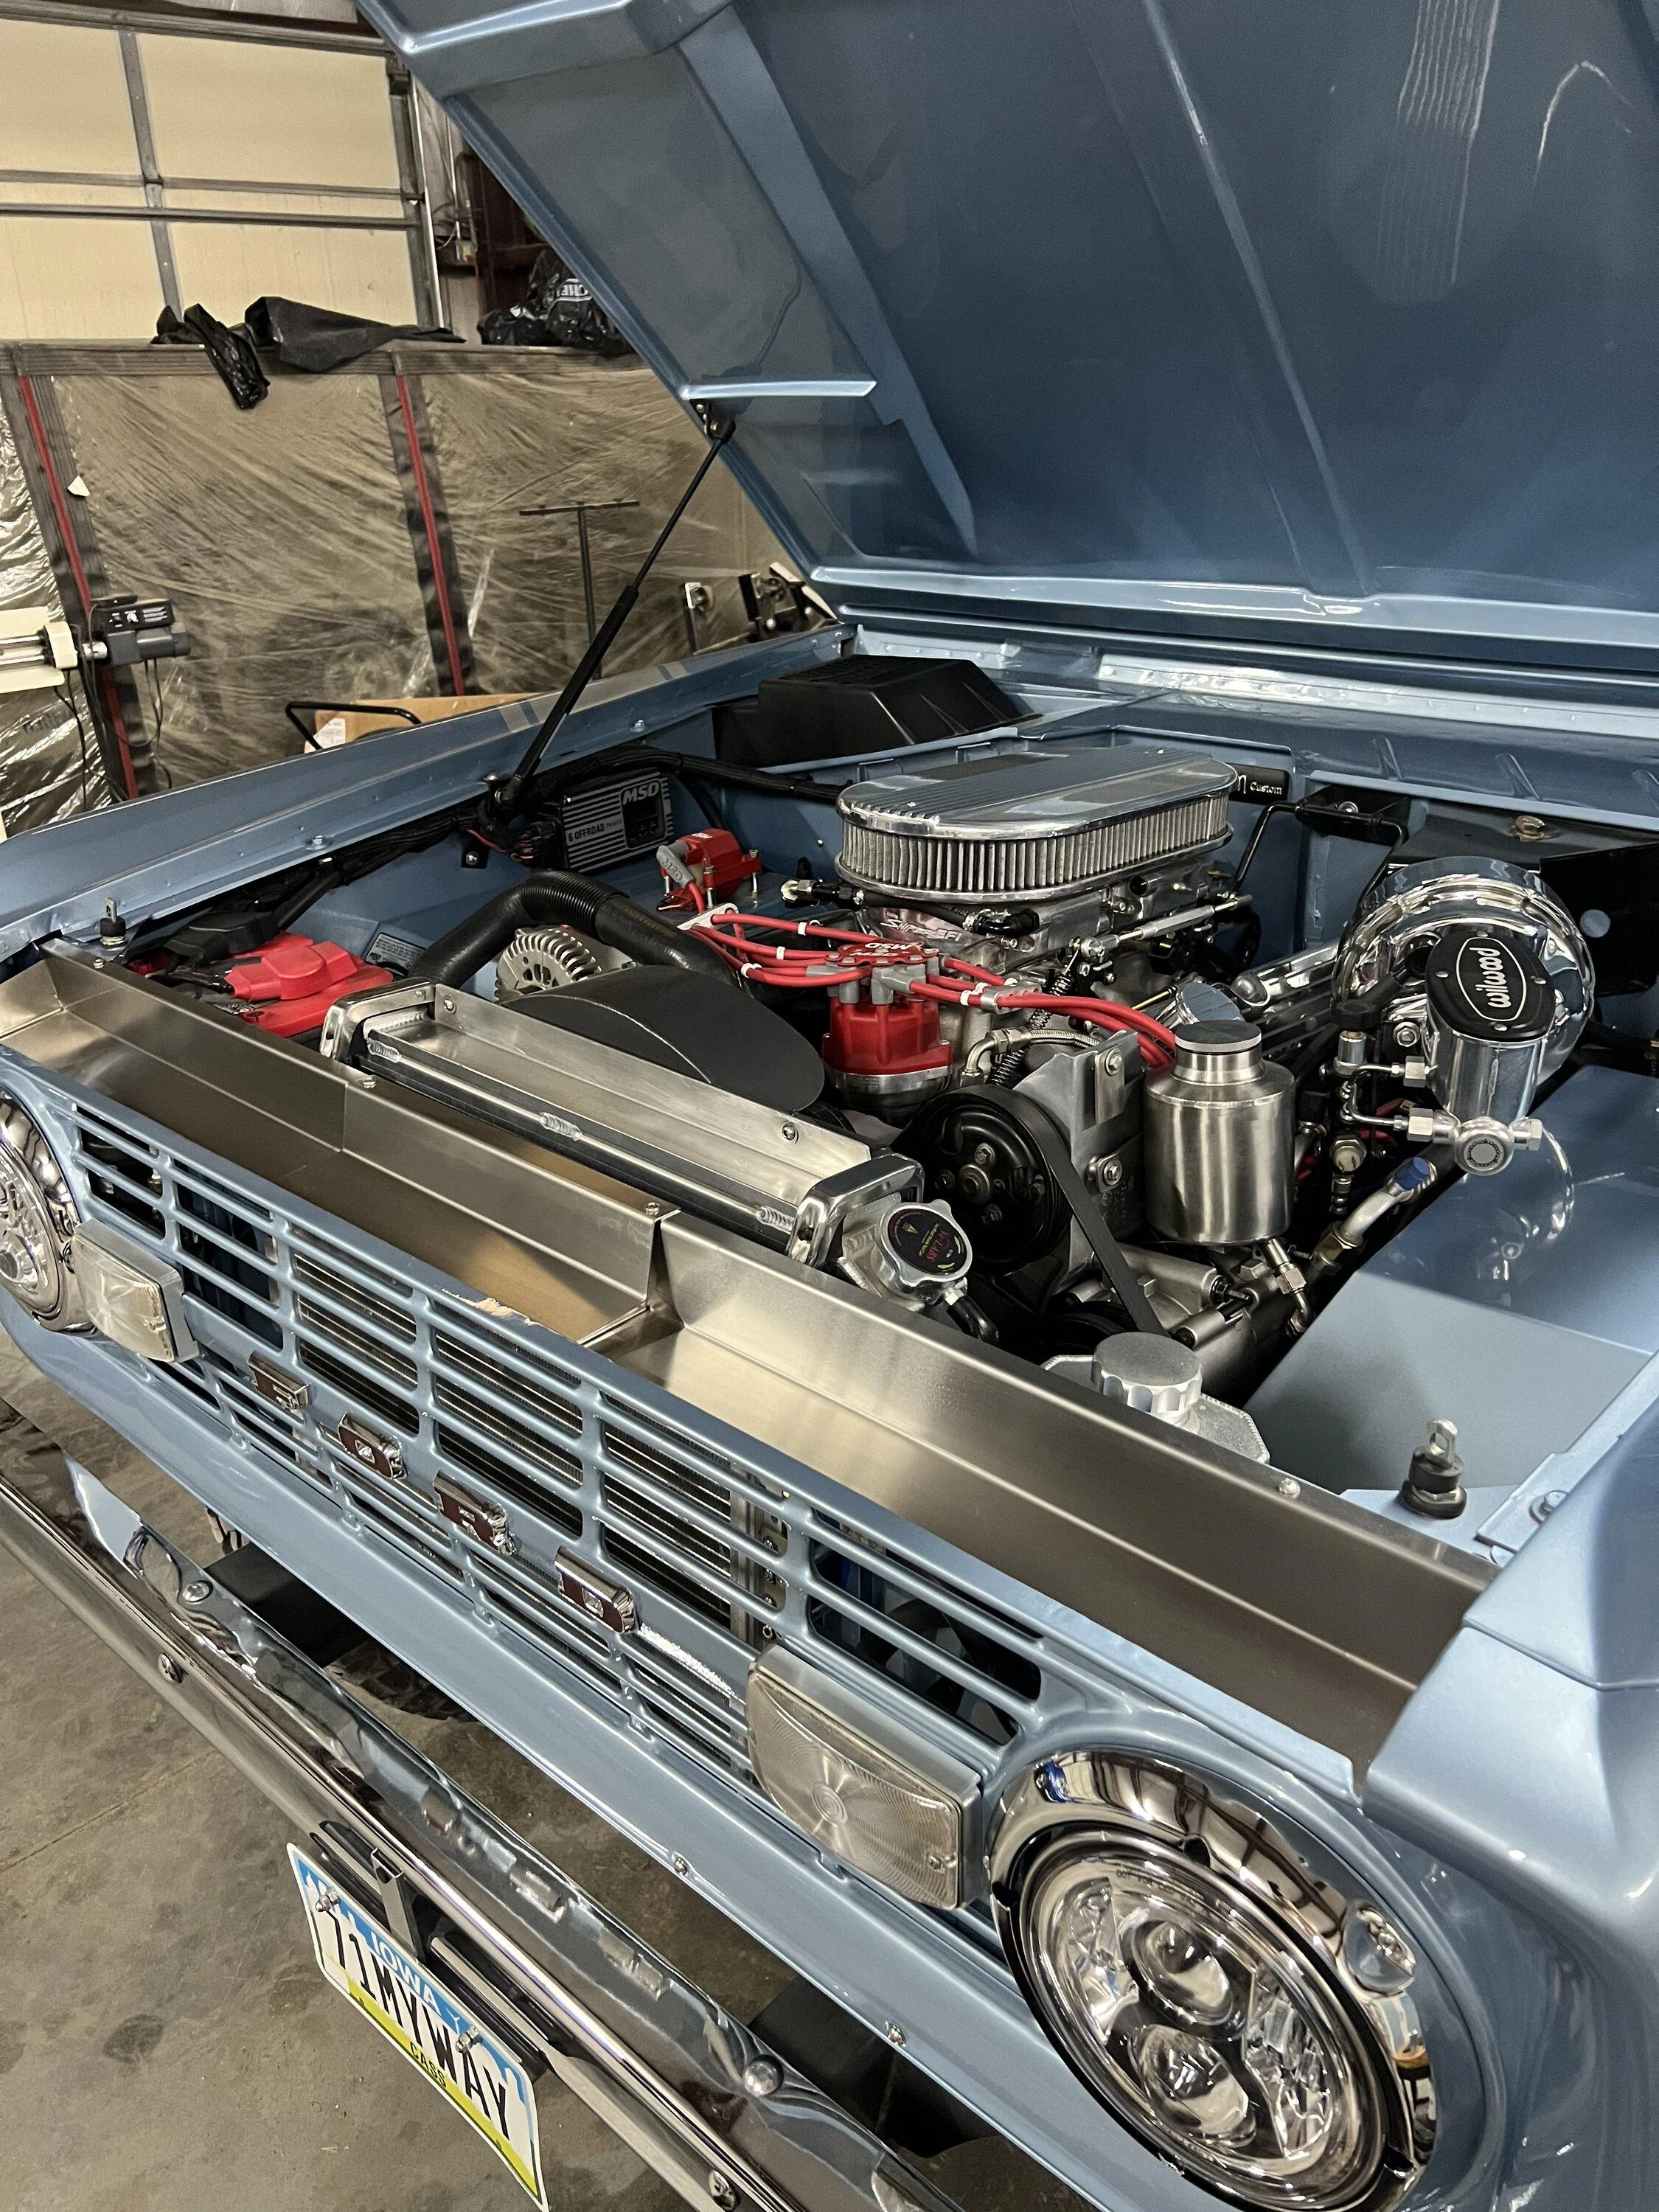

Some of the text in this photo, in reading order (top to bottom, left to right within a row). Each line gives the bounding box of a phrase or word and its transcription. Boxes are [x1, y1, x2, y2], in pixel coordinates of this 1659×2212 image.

[622, 781, 660, 805] MSD
[1250, 782, 1282, 795] Custom
[568, 832, 574, 842] 6
[574, 823, 605, 841] OFFROAD
[1469, 947, 1512, 1008] wilwood
[371, 1930, 442, 2014] IOWA
[327, 1910, 511, 2141] 71MYWAY
[409, 2041, 448, 2089] CASS
